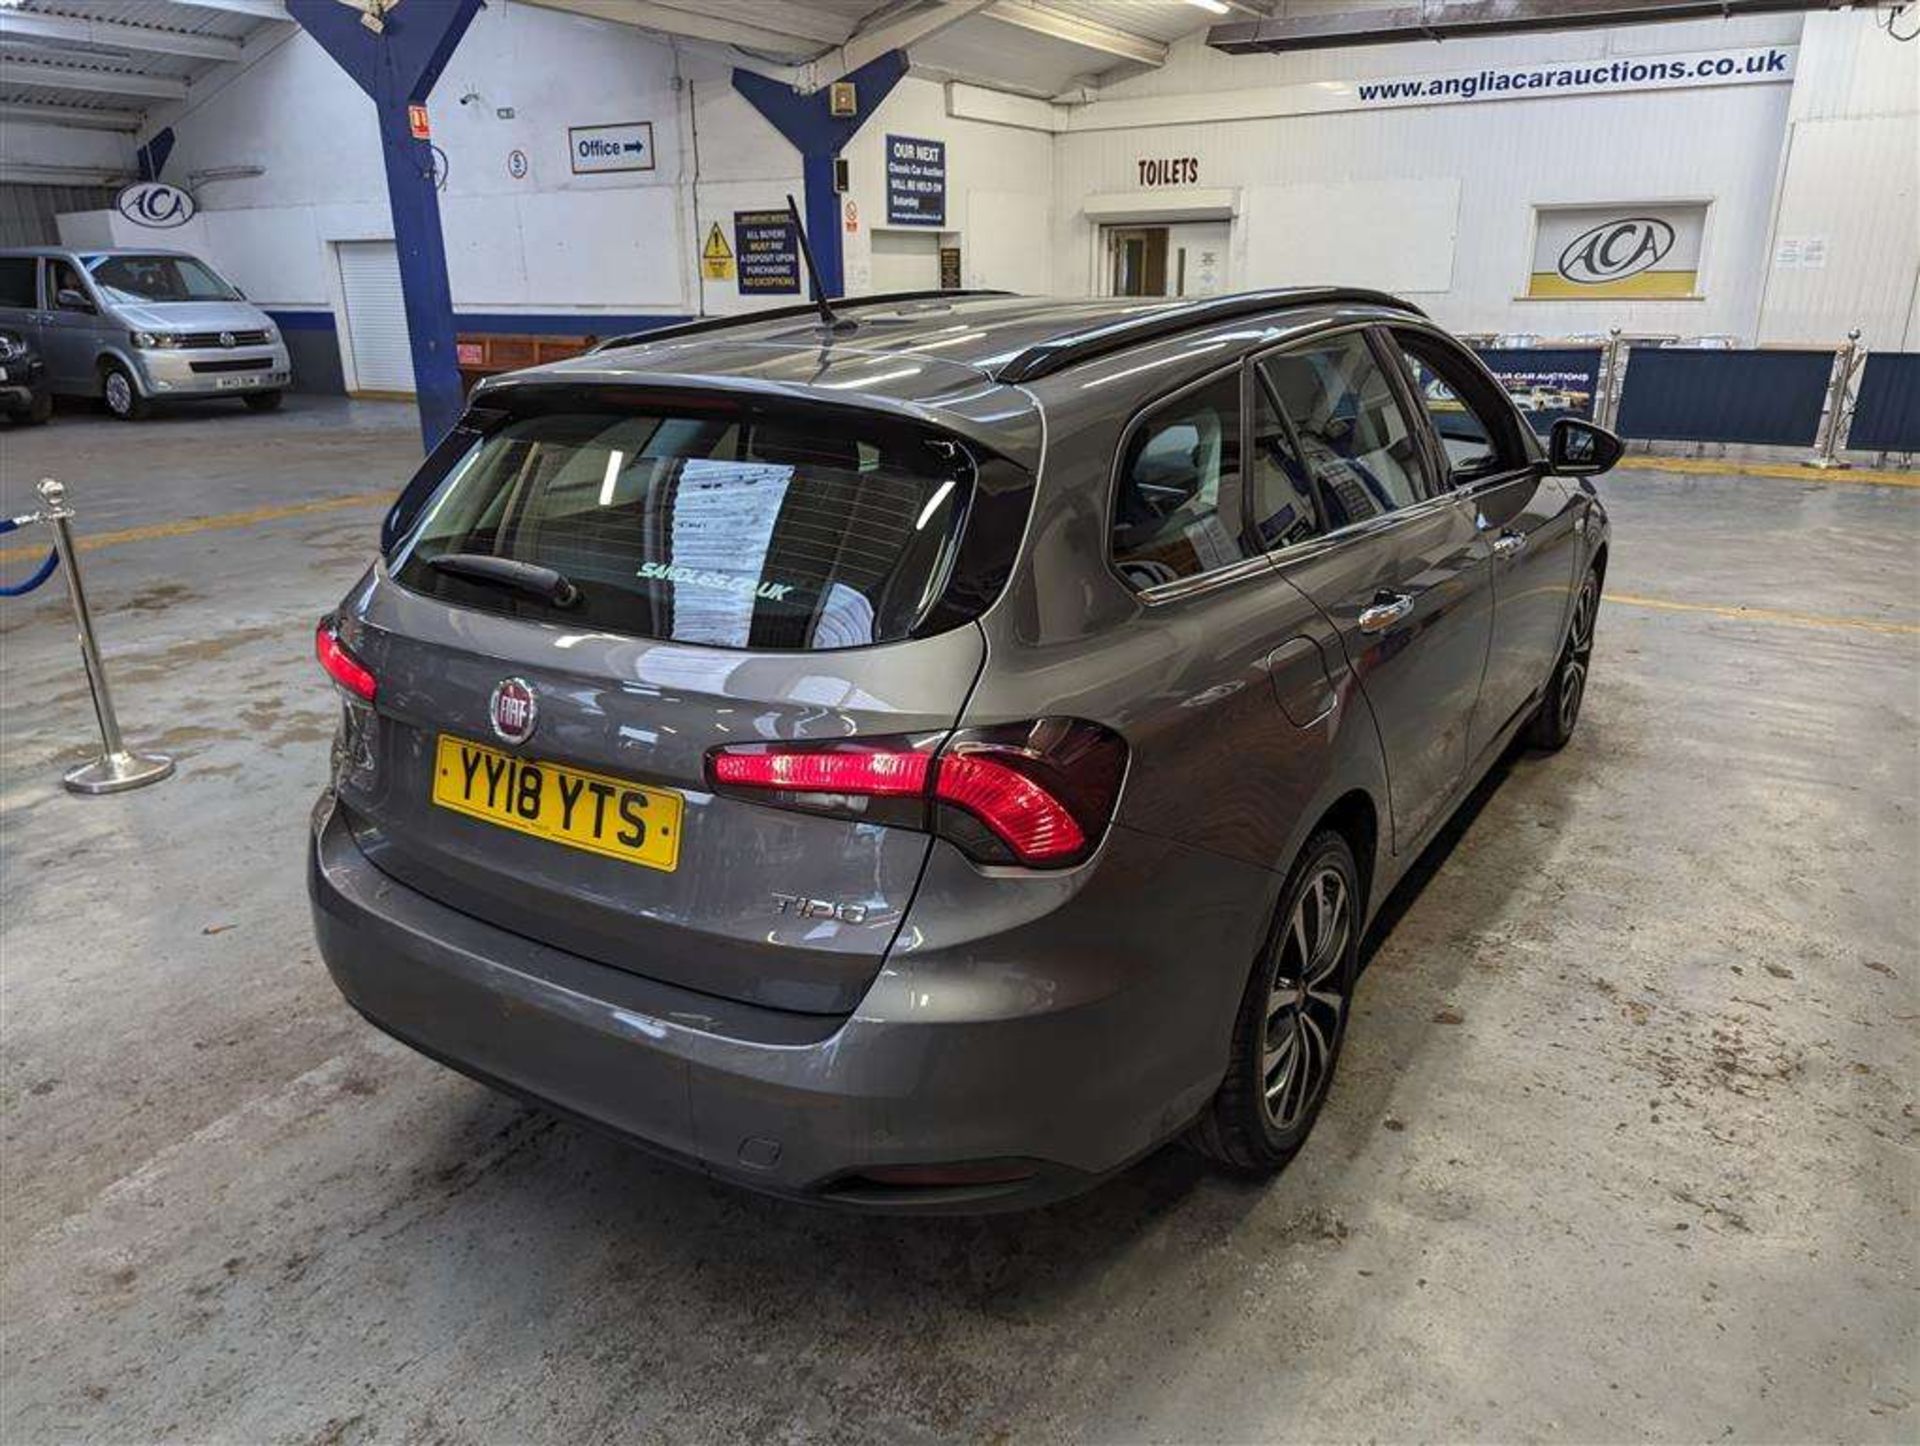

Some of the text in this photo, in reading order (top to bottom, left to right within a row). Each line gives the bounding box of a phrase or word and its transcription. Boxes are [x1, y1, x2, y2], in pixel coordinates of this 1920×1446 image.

[1358, 48, 1787, 100] www.angliacarauctions.co.uk
[578, 139, 621, 158] Office
[893, 142, 940, 162] OUR NEXT
[513, 153, 522, 169] 5
[911, 164, 921, 175] Car
[1138, 157, 1198, 186] TOILETS
[891, 179, 906, 190] WILL
[933, 183, 942, 193] ON
[122, 186, 188, 222] ACA
[893, 195, 920, 209] Saturday
[746, 228, 786, 240] ALL BUYERS
[741, 252, 795, 263] A DEPOSIT UPON
[1562, 223, 1659, 276] ACA
[746, 264, 792, 276] PURCHASING
[754, 276, 796, 287] EXCEPTIONS
[1514, 372, 1535, 380] CAR
[1536, 372, 1590, 381] AUCTIONS
[500, 695, 528, 728] FIAT
[461, 746, 649, 849] YY18 YTS
[771, 891, 868, 924] TIPO
